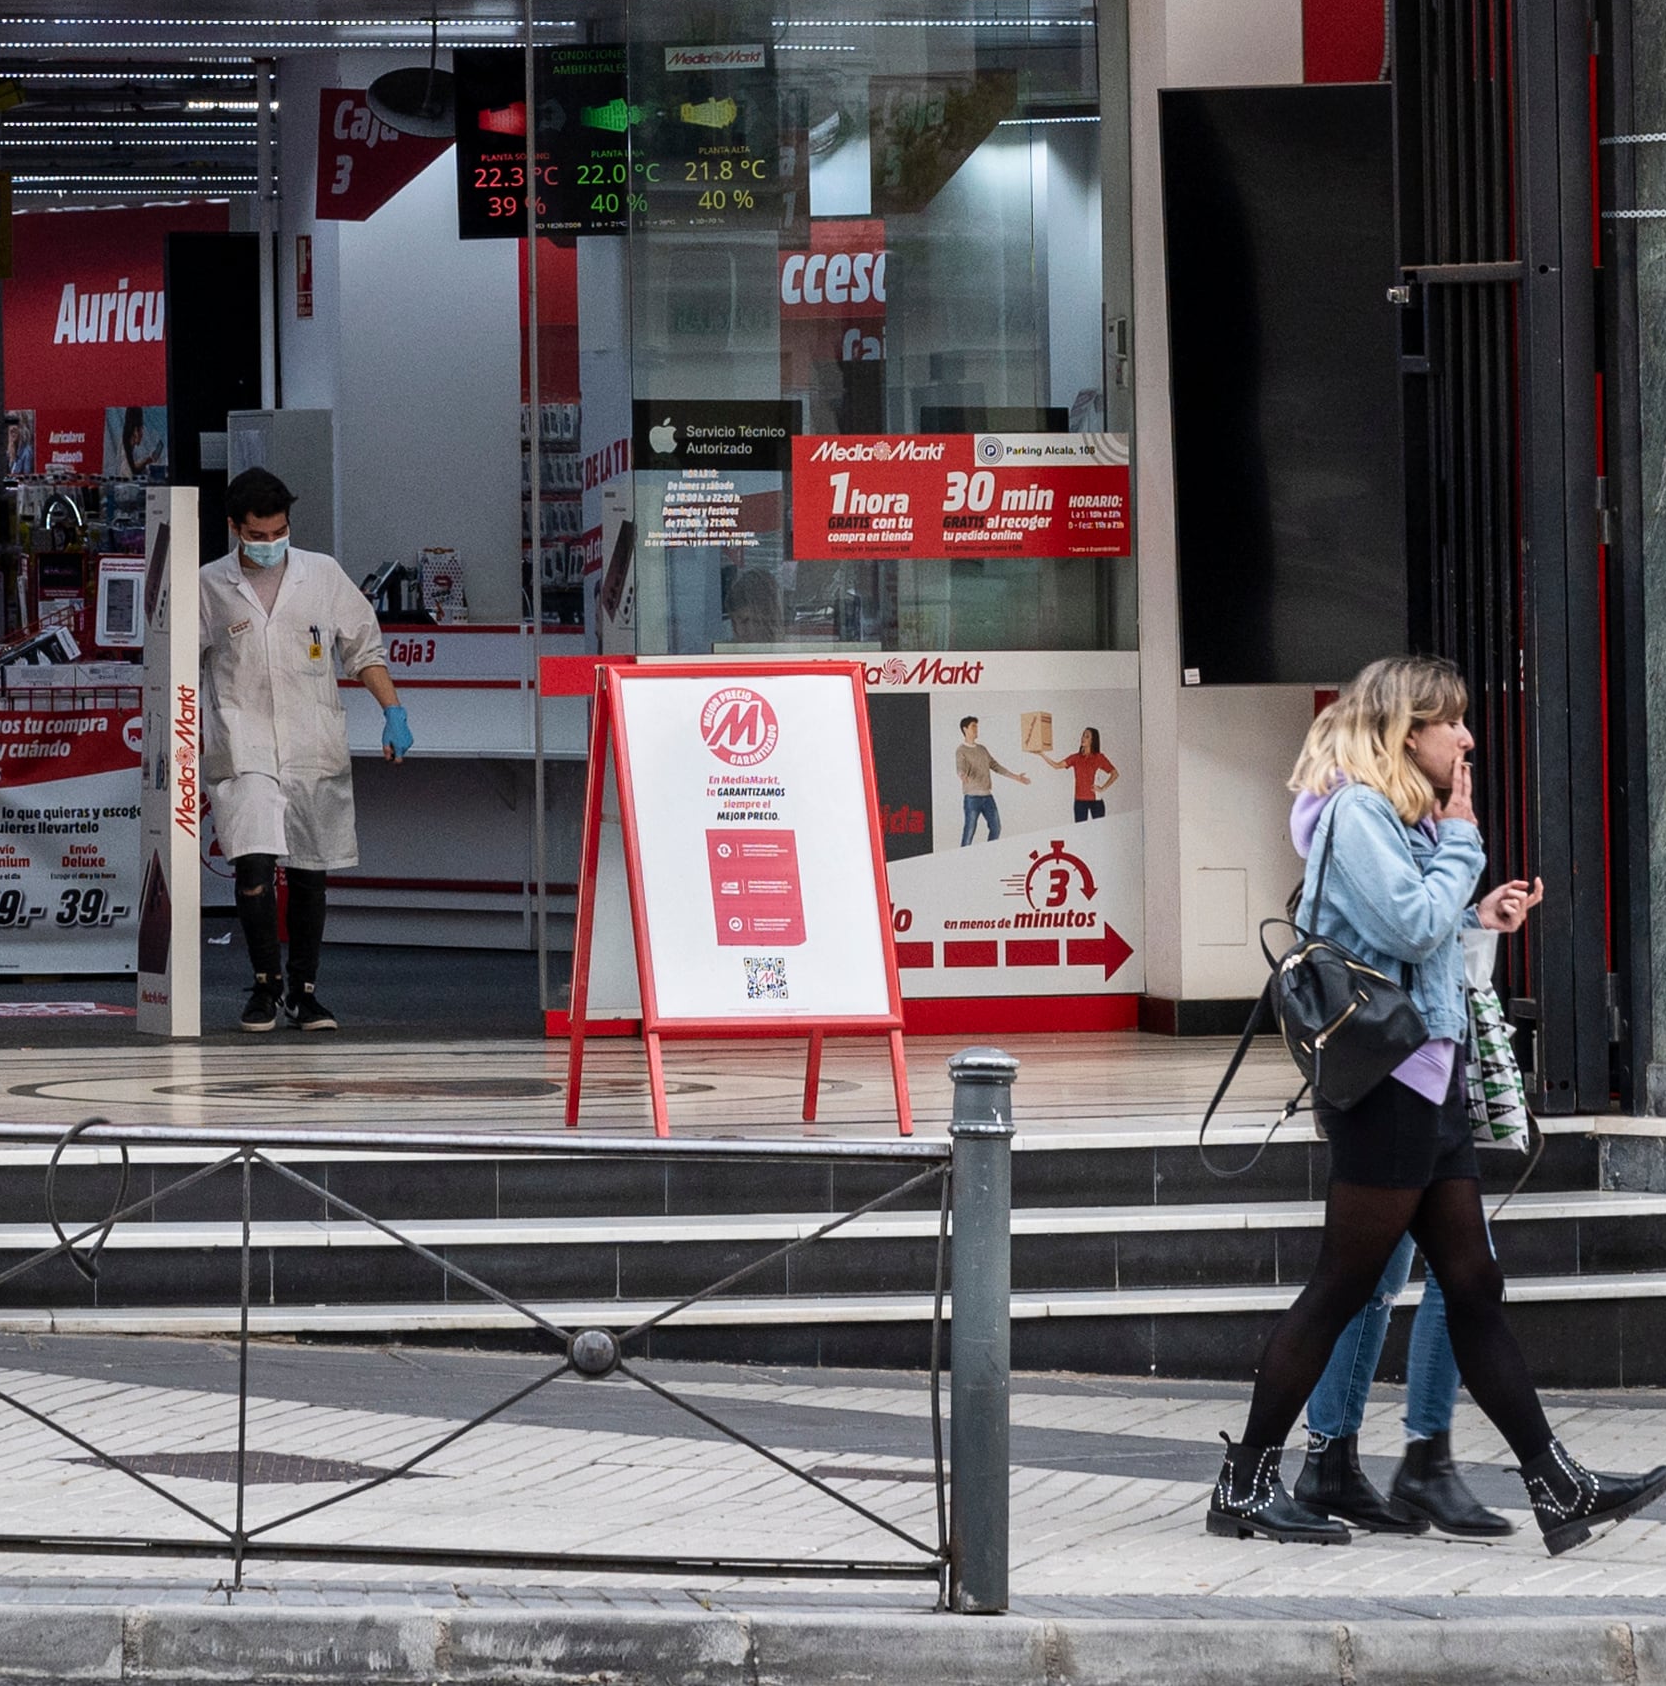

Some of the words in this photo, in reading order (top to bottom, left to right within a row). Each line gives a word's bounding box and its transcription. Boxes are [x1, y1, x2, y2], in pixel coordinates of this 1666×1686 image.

[331, 154, 353, 194] 3
[474, 167, 525, 188] 22.3
[577, 164, 627, 185] 22.0
[685, 160, 734, 182] 21.8
[488, 196, 518, 217] 39
[590, 193, 620, 213] 40
[698, 190, 727, 210] 40
[686, 425, 736, 438] Servicio
[738, 425, 786, 438] Técnico
[686, 442, 753, 455] Autorizado
[810, 440, 875, 462] Media
[888, 439, 946, 462] Markt
[1005, 445, 1042, 457] Parking
[829, 470, 851, 515] 1
[849, 488, 910, 515] hora
[942, 470, 996, 513] 30
[1001, 483, 1055, 512] min
[1068, 494, 1123, 508] HORARIO:
[828, 516, 870, 530] GRATIS
[872, 517, 896, 530] con
[897, 516, 913, 530] tu
[942, 515, 985, 529] GRATIS
[999, 516, 1052, 531] recoger
[828, 531, 865, 544] compra
[880, 530, 913, 543] tienda
[954, 529, 990, 543] pedido
[991, 529, 1023, 541] online
[389, 639, 423, 667] Caja
[425, 639, 436, 664] 3
[902, 657, 985, 685] Markt
[24, 717, 44, 734] tu
[45, 716, 109, 735] compra
[8, 738, 72, 757] cuándo
[717, 787, 786, 797] GARANTIZAMOS
[16, 808, 41, 821] que
[42, 806, 91, 821] quieras
[37, 822, 100, 834] llevartelo
[61, 856, 106, 868] Deluxe
[1045, 868, 1071, 908] 3
[944, 919, 958, 930] en
[959, 919, 996, 930] menos
[997, 917, 1012, 929] de
[1013, 909, 1097, 929] minutos
